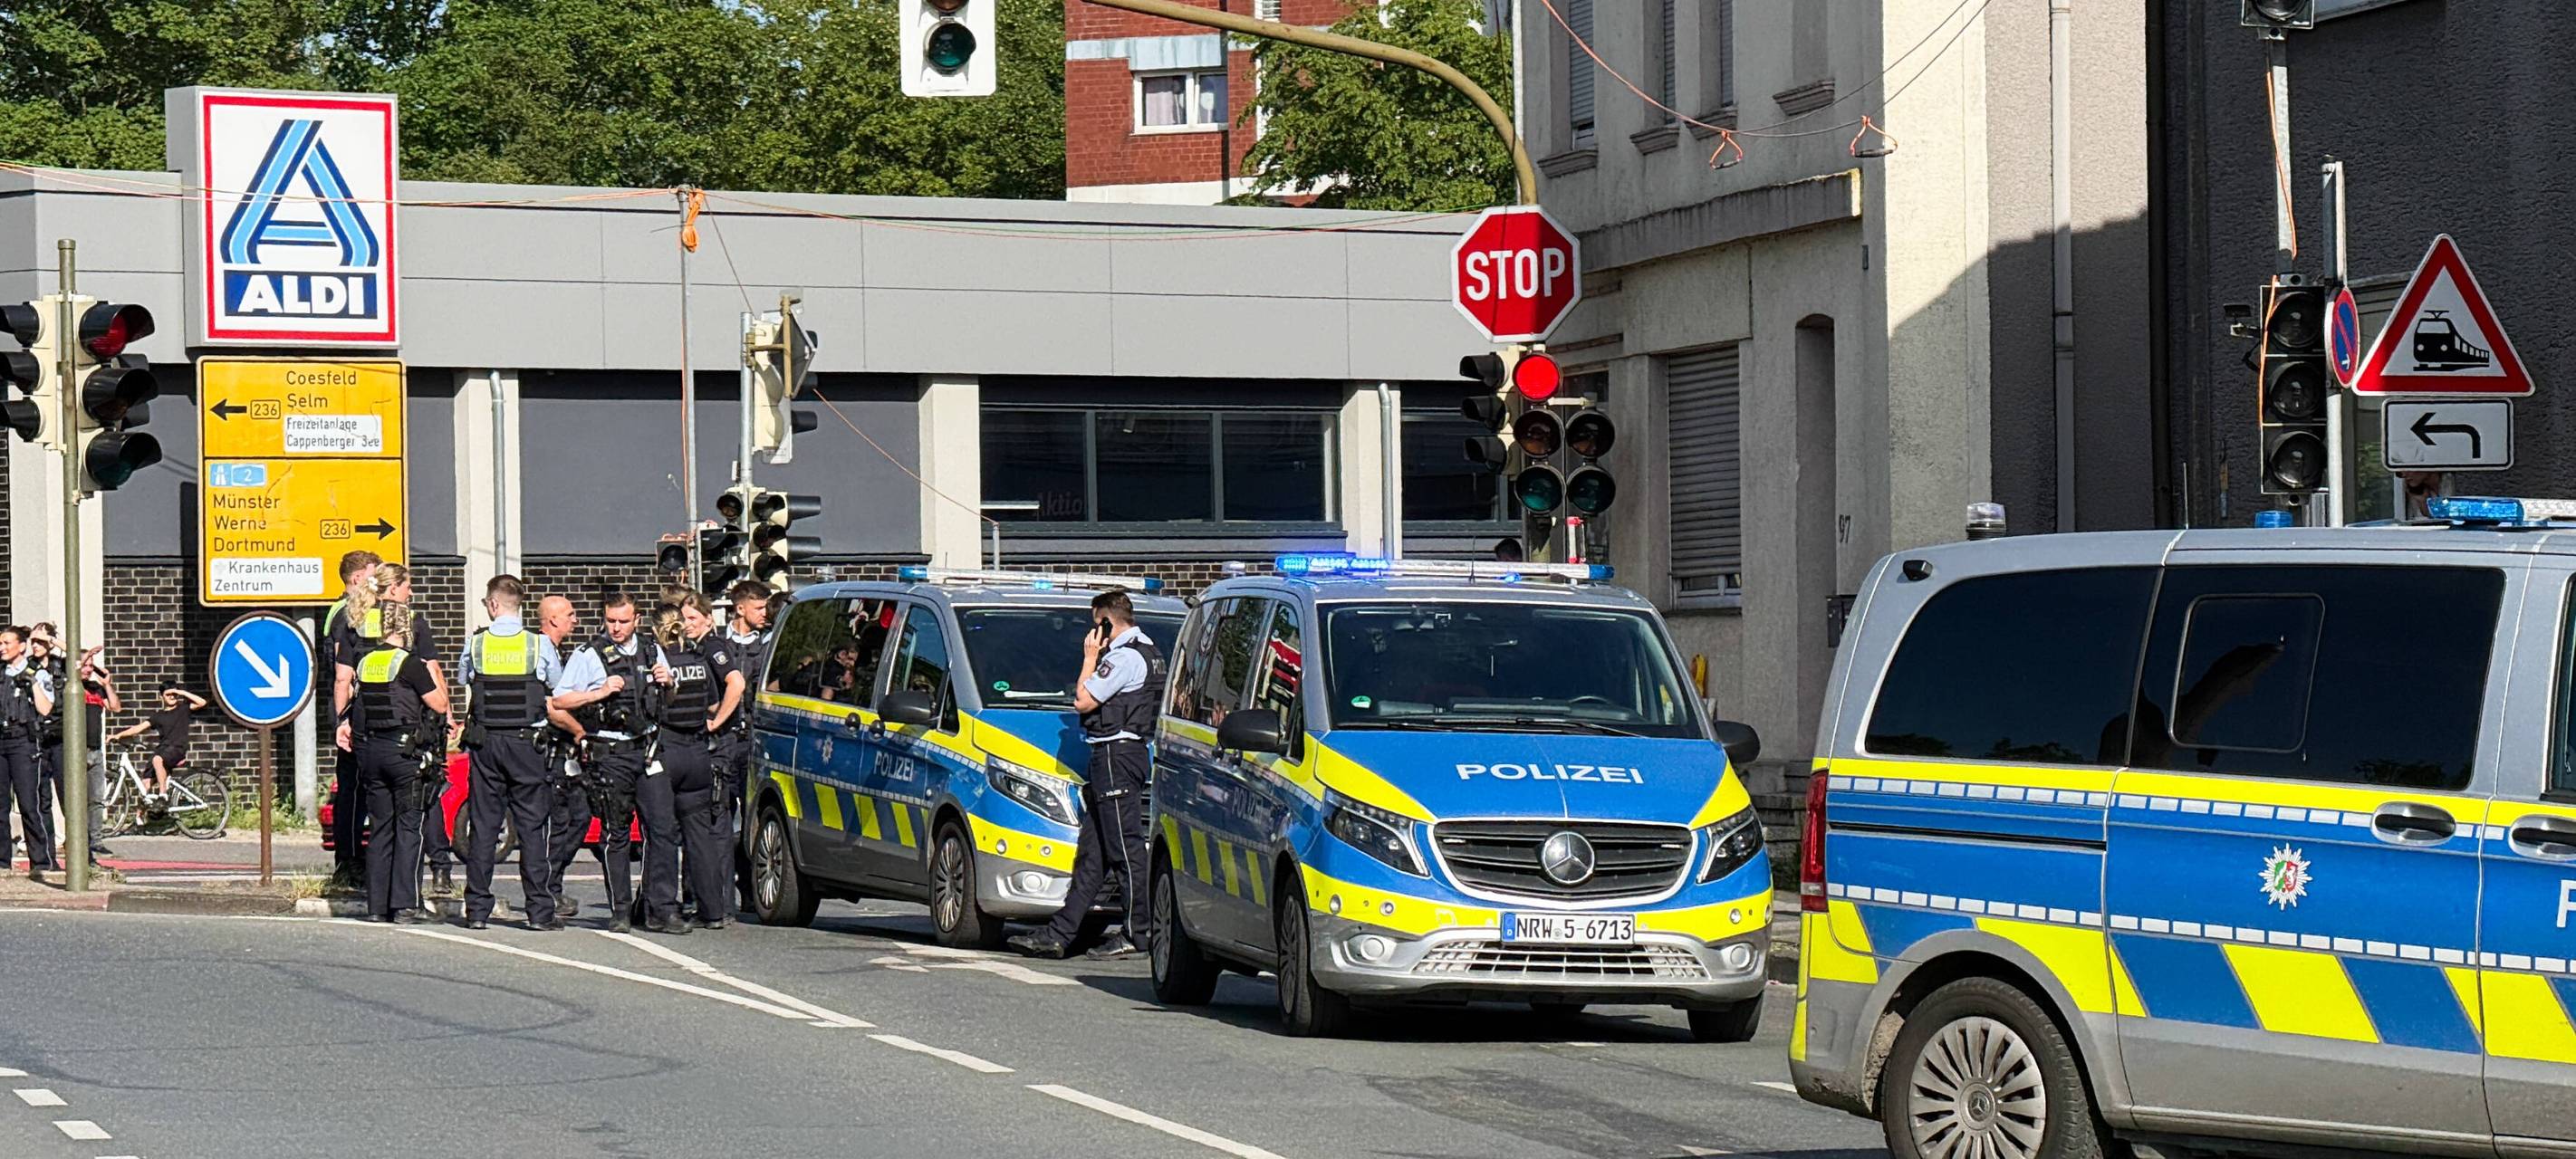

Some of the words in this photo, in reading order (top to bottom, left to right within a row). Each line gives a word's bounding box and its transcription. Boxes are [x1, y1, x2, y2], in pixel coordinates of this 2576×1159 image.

[1466, 248, 1566, 301] STOP
[237, 274, 364, 315] ALDI
[286, 370, 357, 385] Coesfeld
[287, 393, 328, 407] Selm
[254, 403, 277, 416] 236
[244, 469, 253, 482] 2
[213, 493, 281, 509] Münster
[214, 515, 267, 530] Werne
[324, 522, 347, 535] 236
[1839, 514, 1851, 543] 97
[214, 536, 295, 551] Dortmund
[228, 560, 320, 573] Krankenhaus
[215, 579, 273, 591] Zentrum
[486, 653, 523, 665] POLIZEI
[671, 666, 706, 681] OLIZEI
[873, 751, 914, 782] POLIZEI
[1456, 763, 1645, 784] POLIZEI
[1516, 918, 1553, 938] NRW
